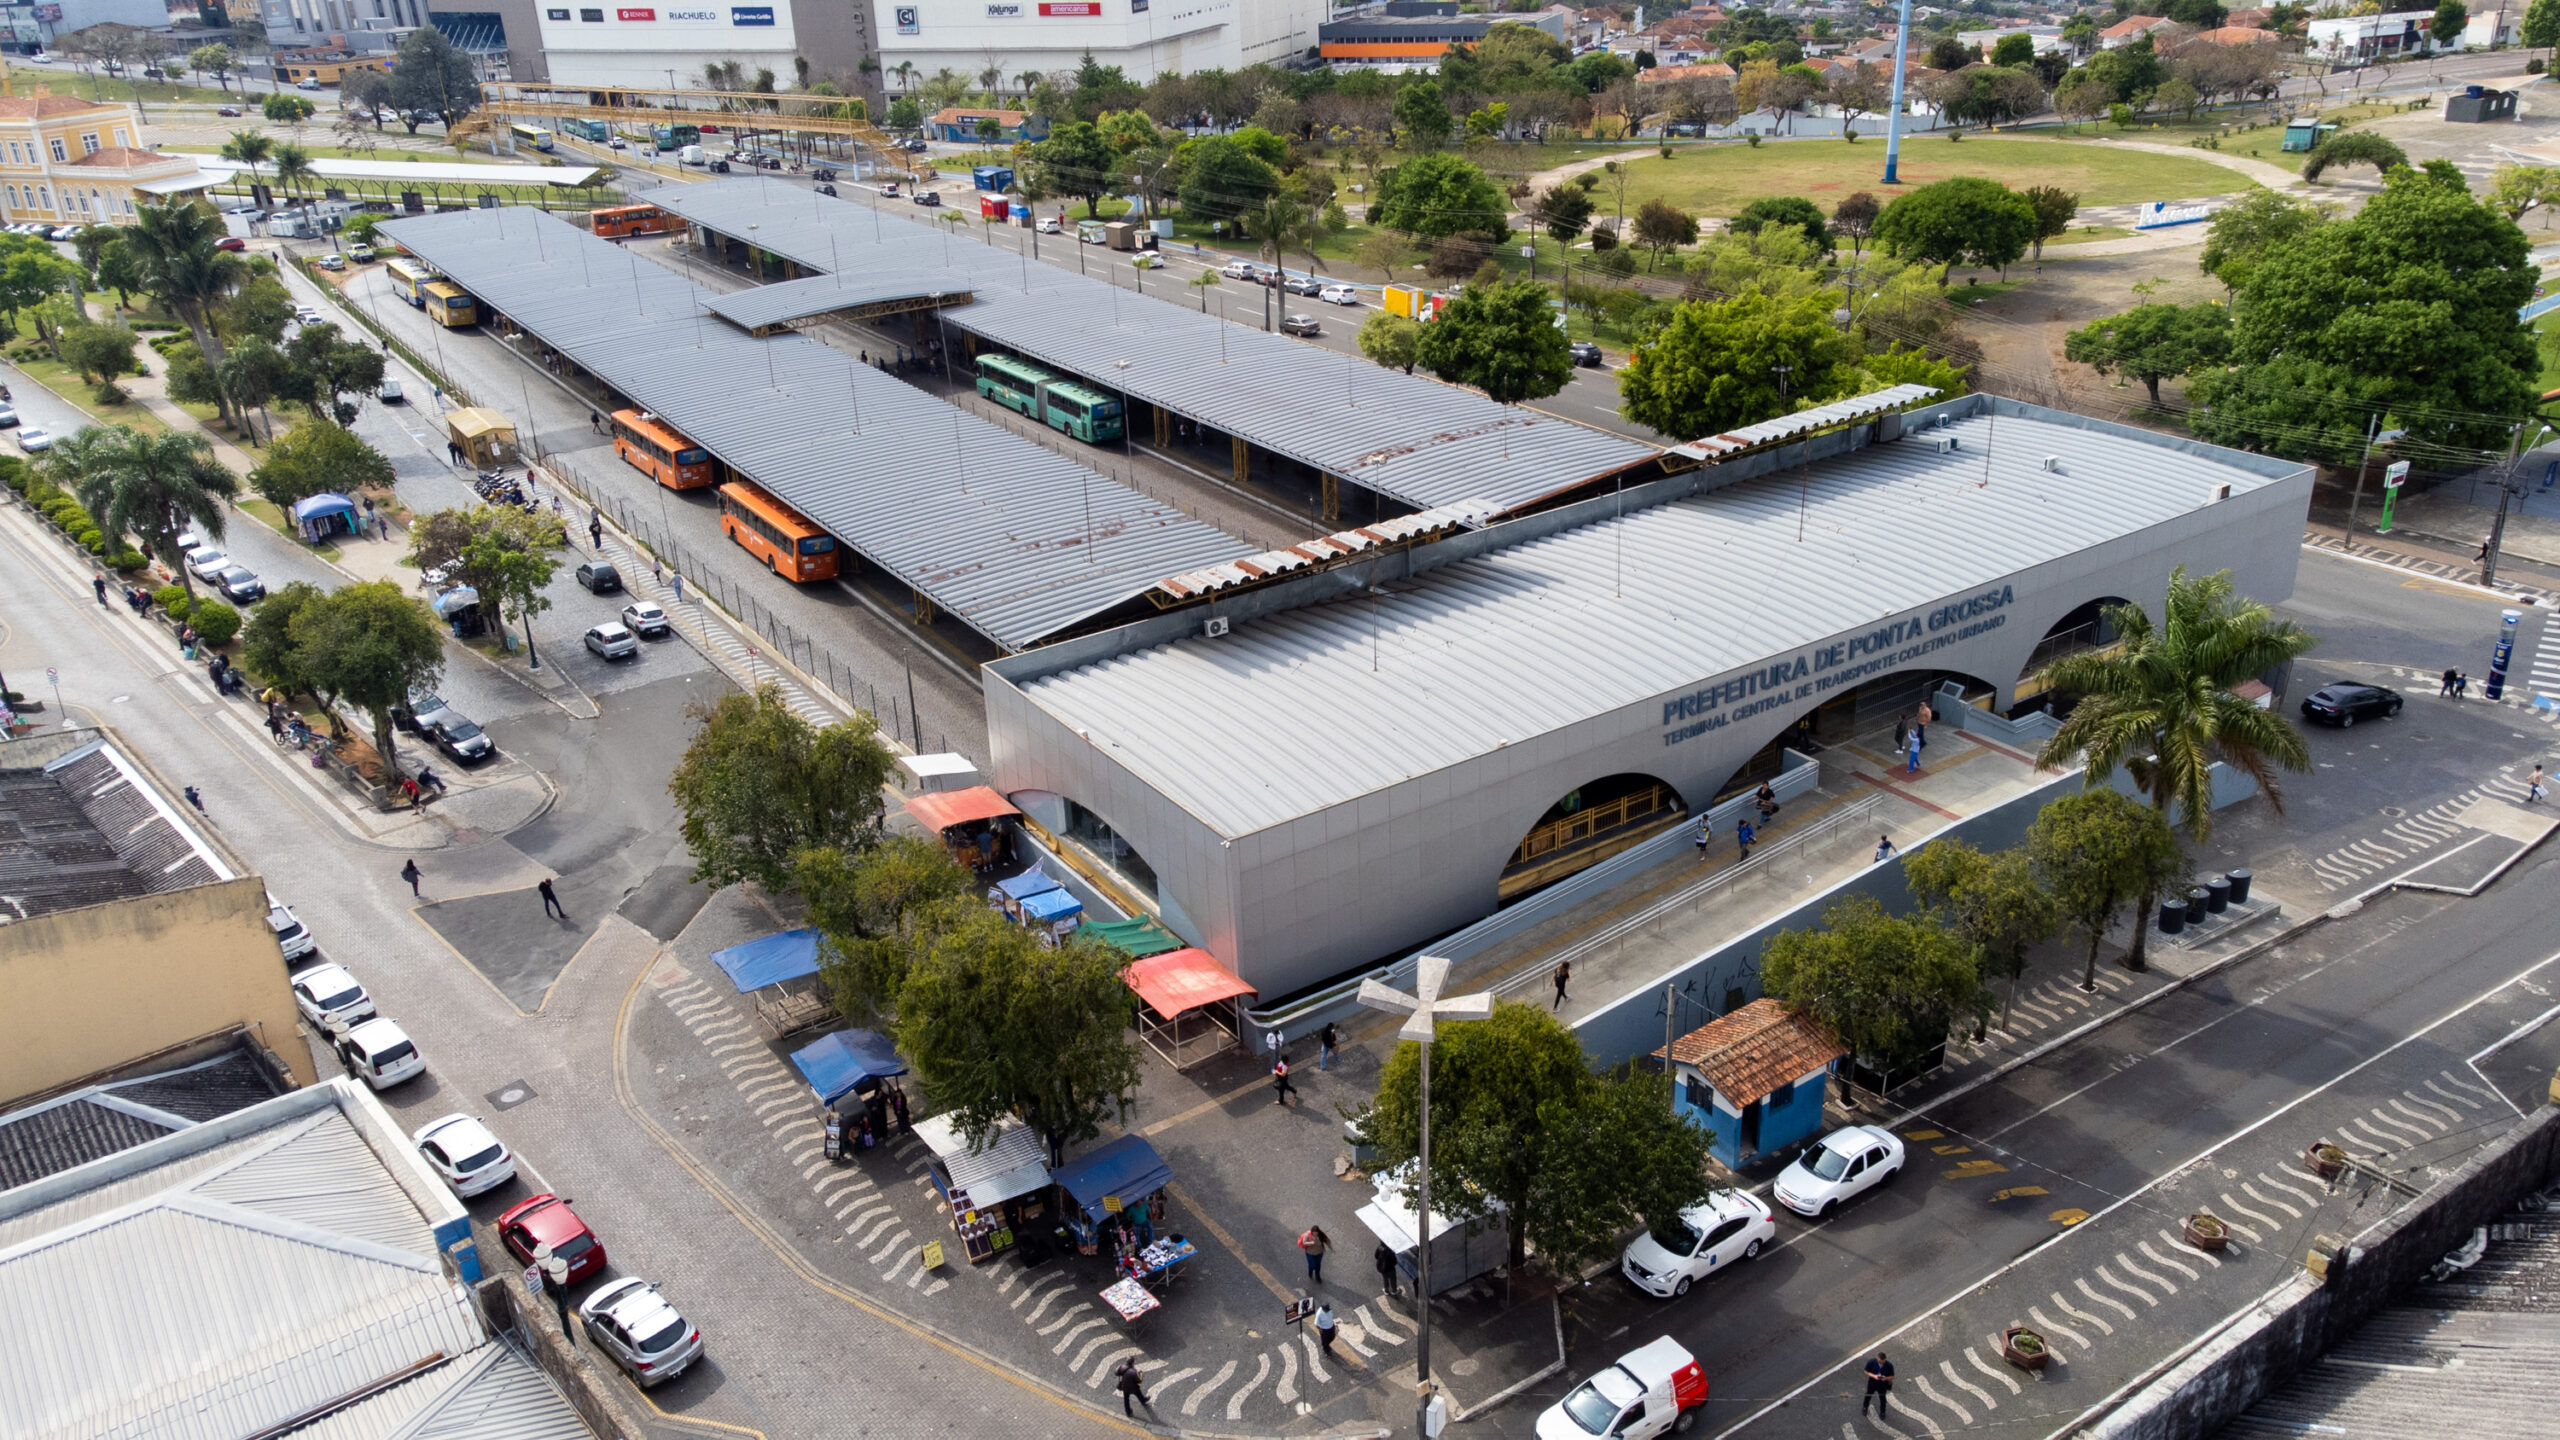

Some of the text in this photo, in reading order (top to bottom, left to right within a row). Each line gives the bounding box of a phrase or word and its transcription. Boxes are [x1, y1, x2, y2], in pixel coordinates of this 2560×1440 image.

[668, 11, 716, 20] RIACHUELO
[1663, 614, 2006, 746] TERMINAL CENTRAL DE TRANSPORTE COLETIVO URBANO
[1664, 584, 2014, 726] PREFEITURA DE PONTA GROSSA
